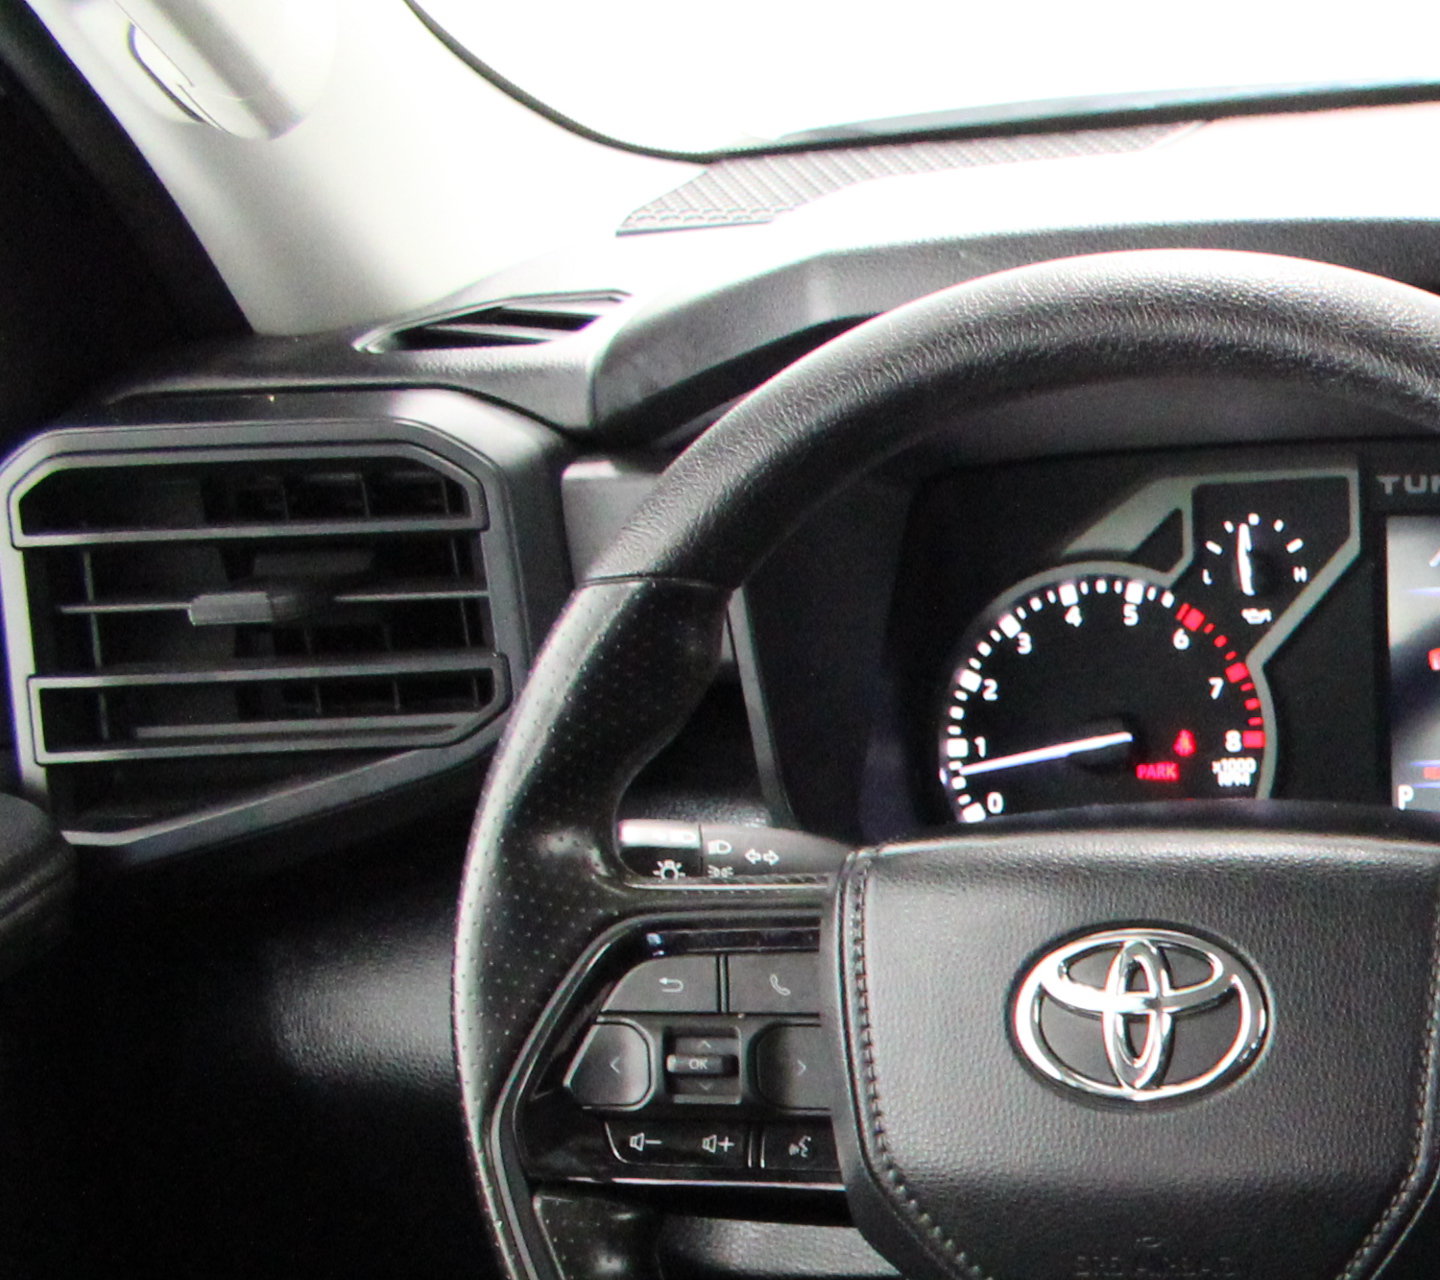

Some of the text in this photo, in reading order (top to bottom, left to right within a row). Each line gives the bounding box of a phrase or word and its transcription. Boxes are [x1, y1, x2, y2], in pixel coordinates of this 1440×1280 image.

[1292, 566, 1308, 583] H
[1064, 605, 1083, 627] 4
[1122, 603, 1139, 626] 5
[1017, 631, 1032, 654] 3
[1172, 628, 1190, 651] 6
[982, 679, 998, 701] 2
[1207, 677, 1225, 700] 7
[974, 736, 987, 758] 1
[1224, 730, 1242, 752] 8
[1135, 761, 1180, 781] PARK
[986, 792, 1005, 814] 0
[1397, 785, 1414, 811] P
[688, 1058, 708, 1071] OK
